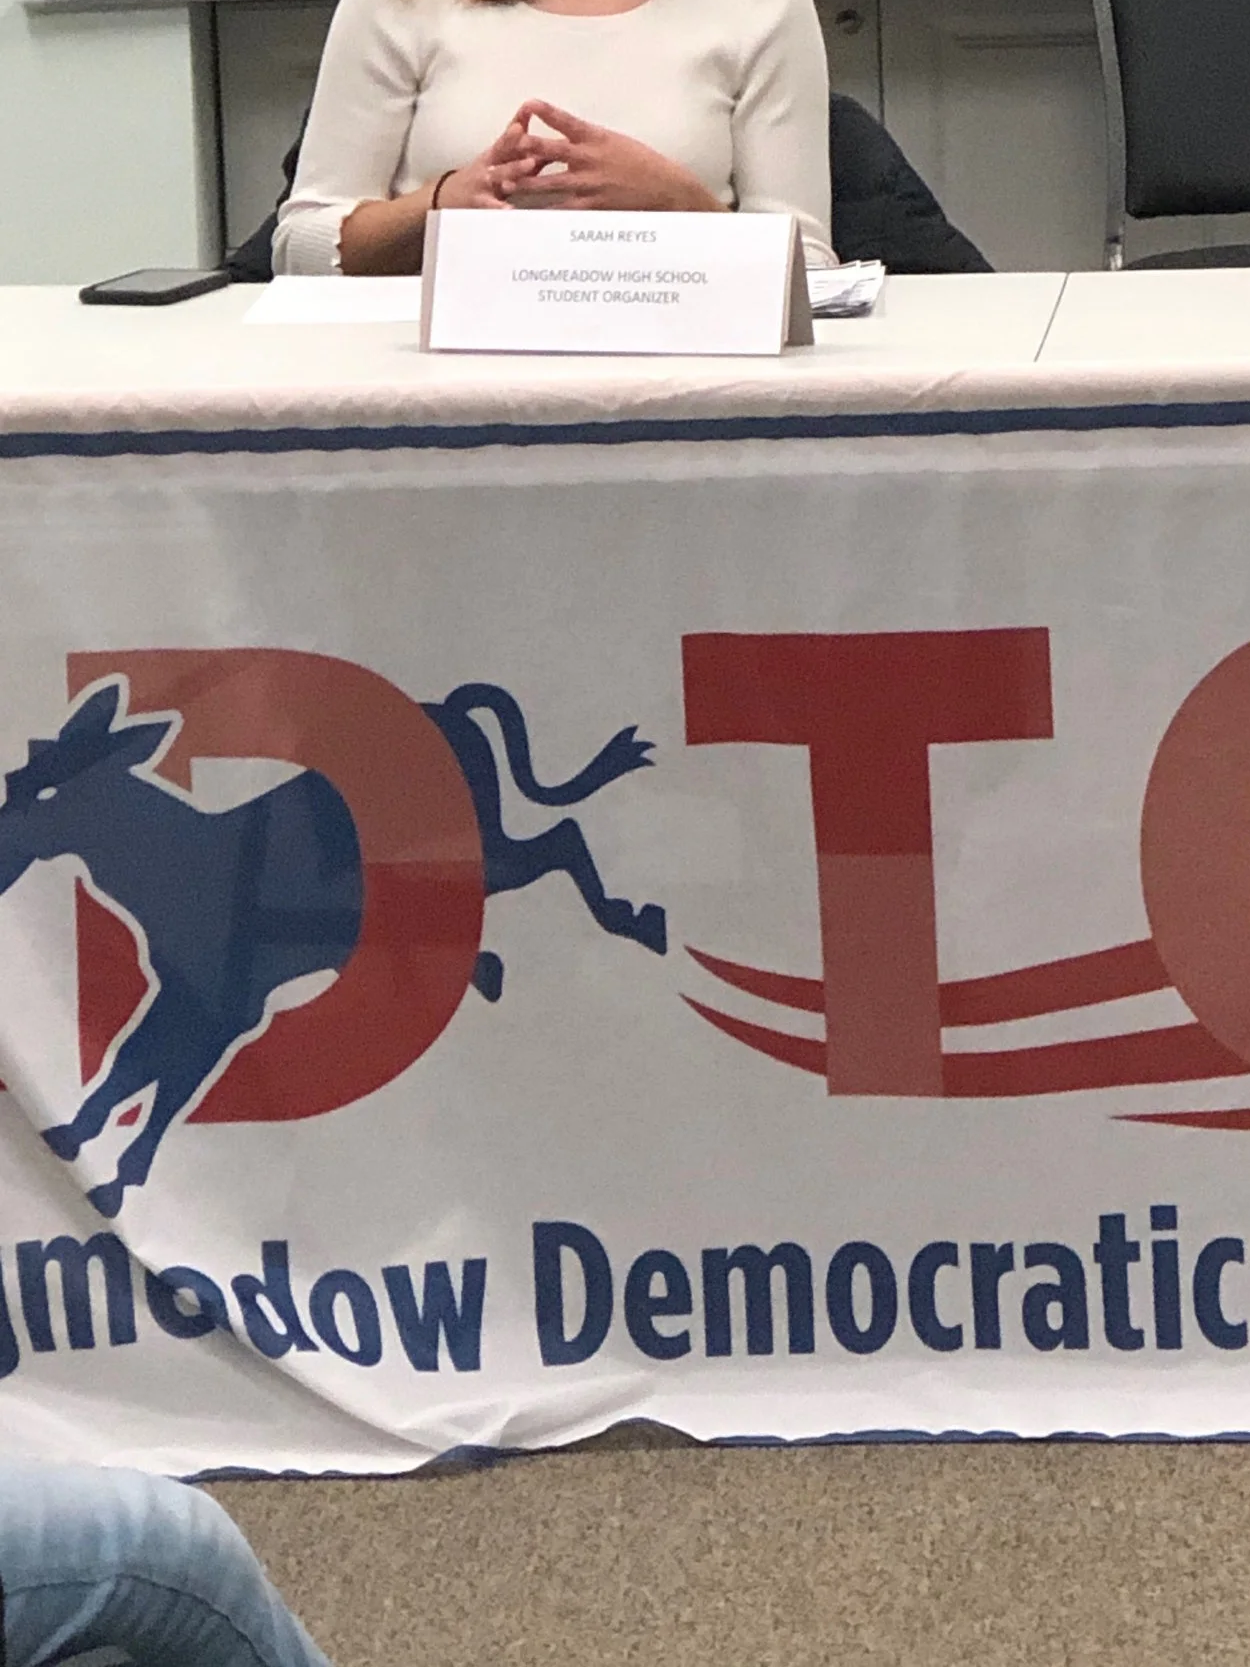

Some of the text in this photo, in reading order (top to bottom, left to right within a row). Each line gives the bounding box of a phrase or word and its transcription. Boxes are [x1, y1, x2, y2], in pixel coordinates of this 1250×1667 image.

[570, 230, 657, 243] SARAH REYES
[512, 269, 709, 284] LONGMEADOW HIGH SCHOOL
[538, 289, 680, 304] STUDENT ORGANIZER
[532, 1204, 1249, 1367] Democratic
